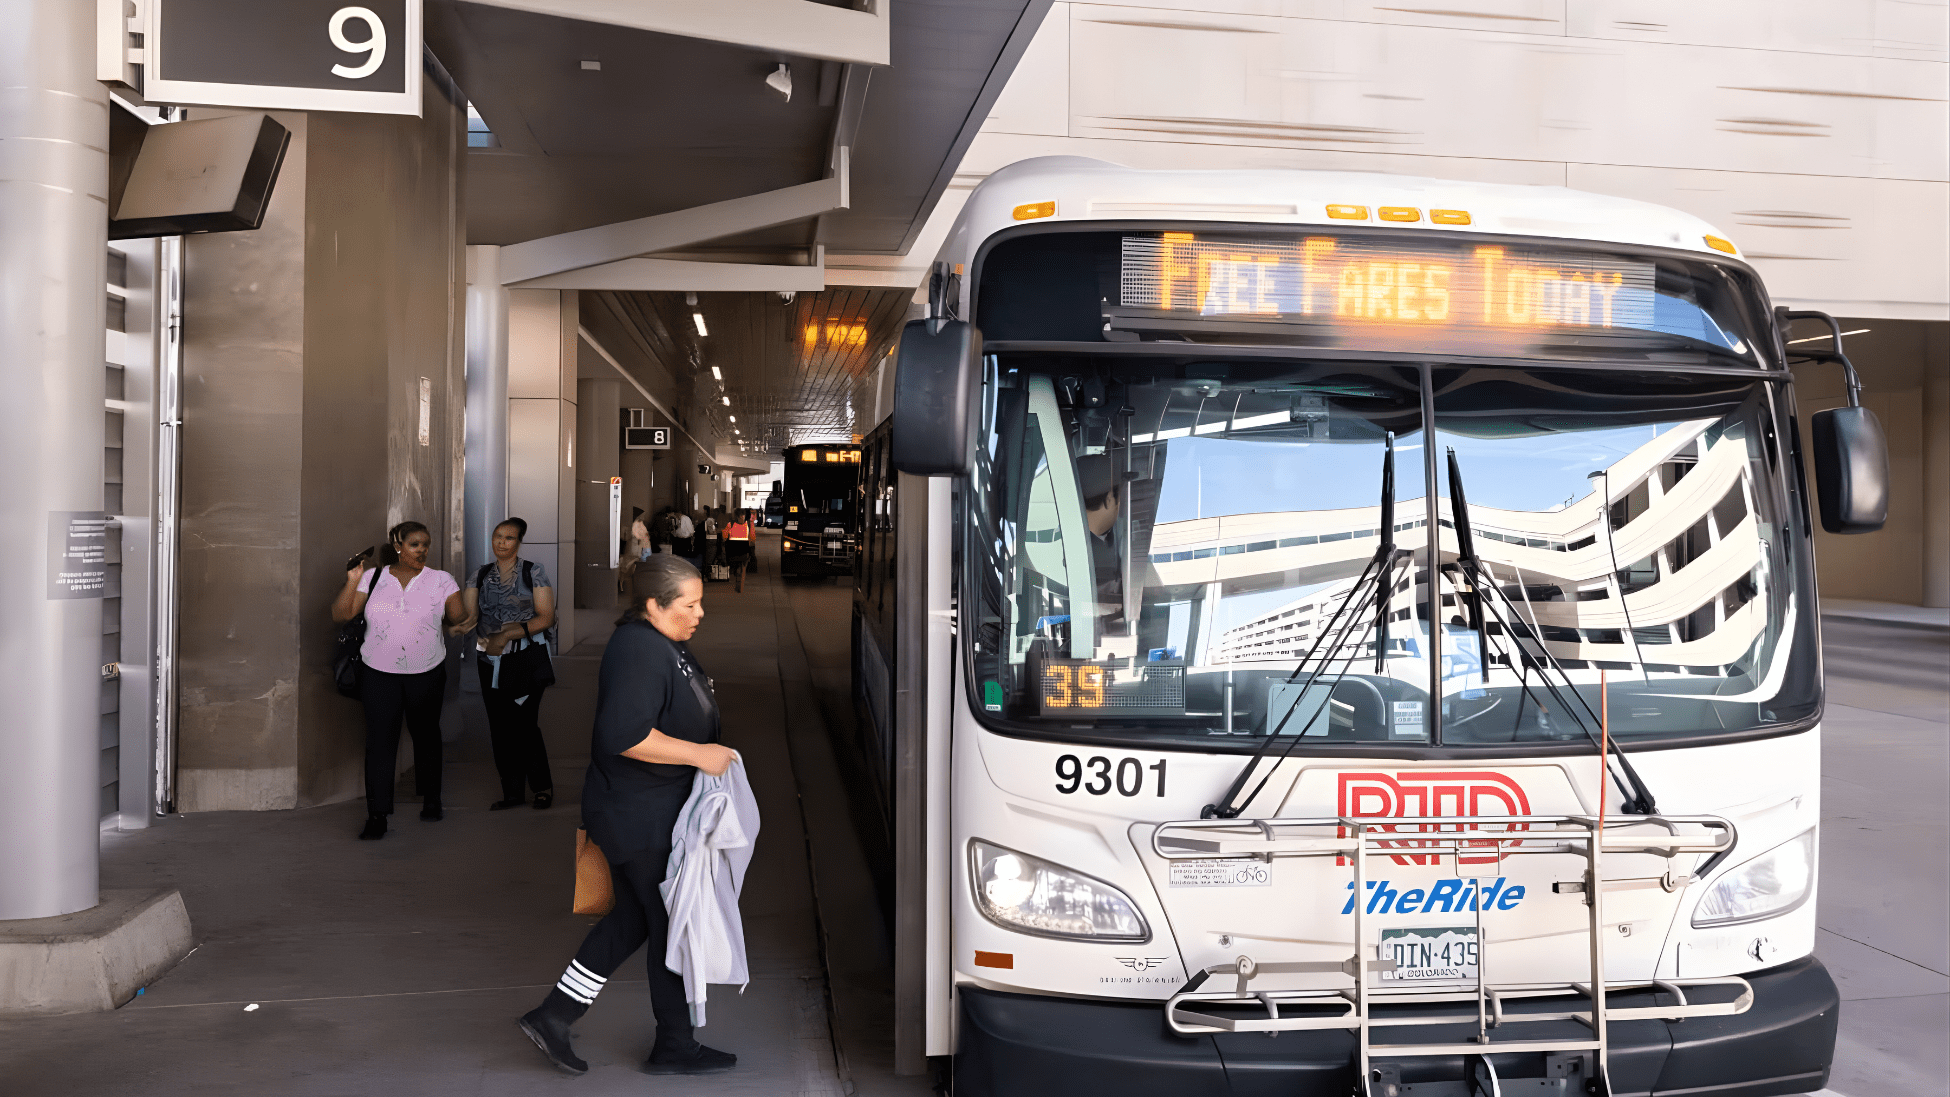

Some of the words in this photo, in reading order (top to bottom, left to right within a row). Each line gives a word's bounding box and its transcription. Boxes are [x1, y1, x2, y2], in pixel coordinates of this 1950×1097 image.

[328, 6, 387, 79] 9
[1303, 236, 1450, 322] FARES
[1473, 245, 1623, 329] TODAY
[654, 430, 665, 444] 8
[1046, 665, 1104, 708] 39
[1055, 754, 1168, 798] 9301
[1336, 772, 1532, 866] RTD
[1341, 877, 1526, 915] TheRide
